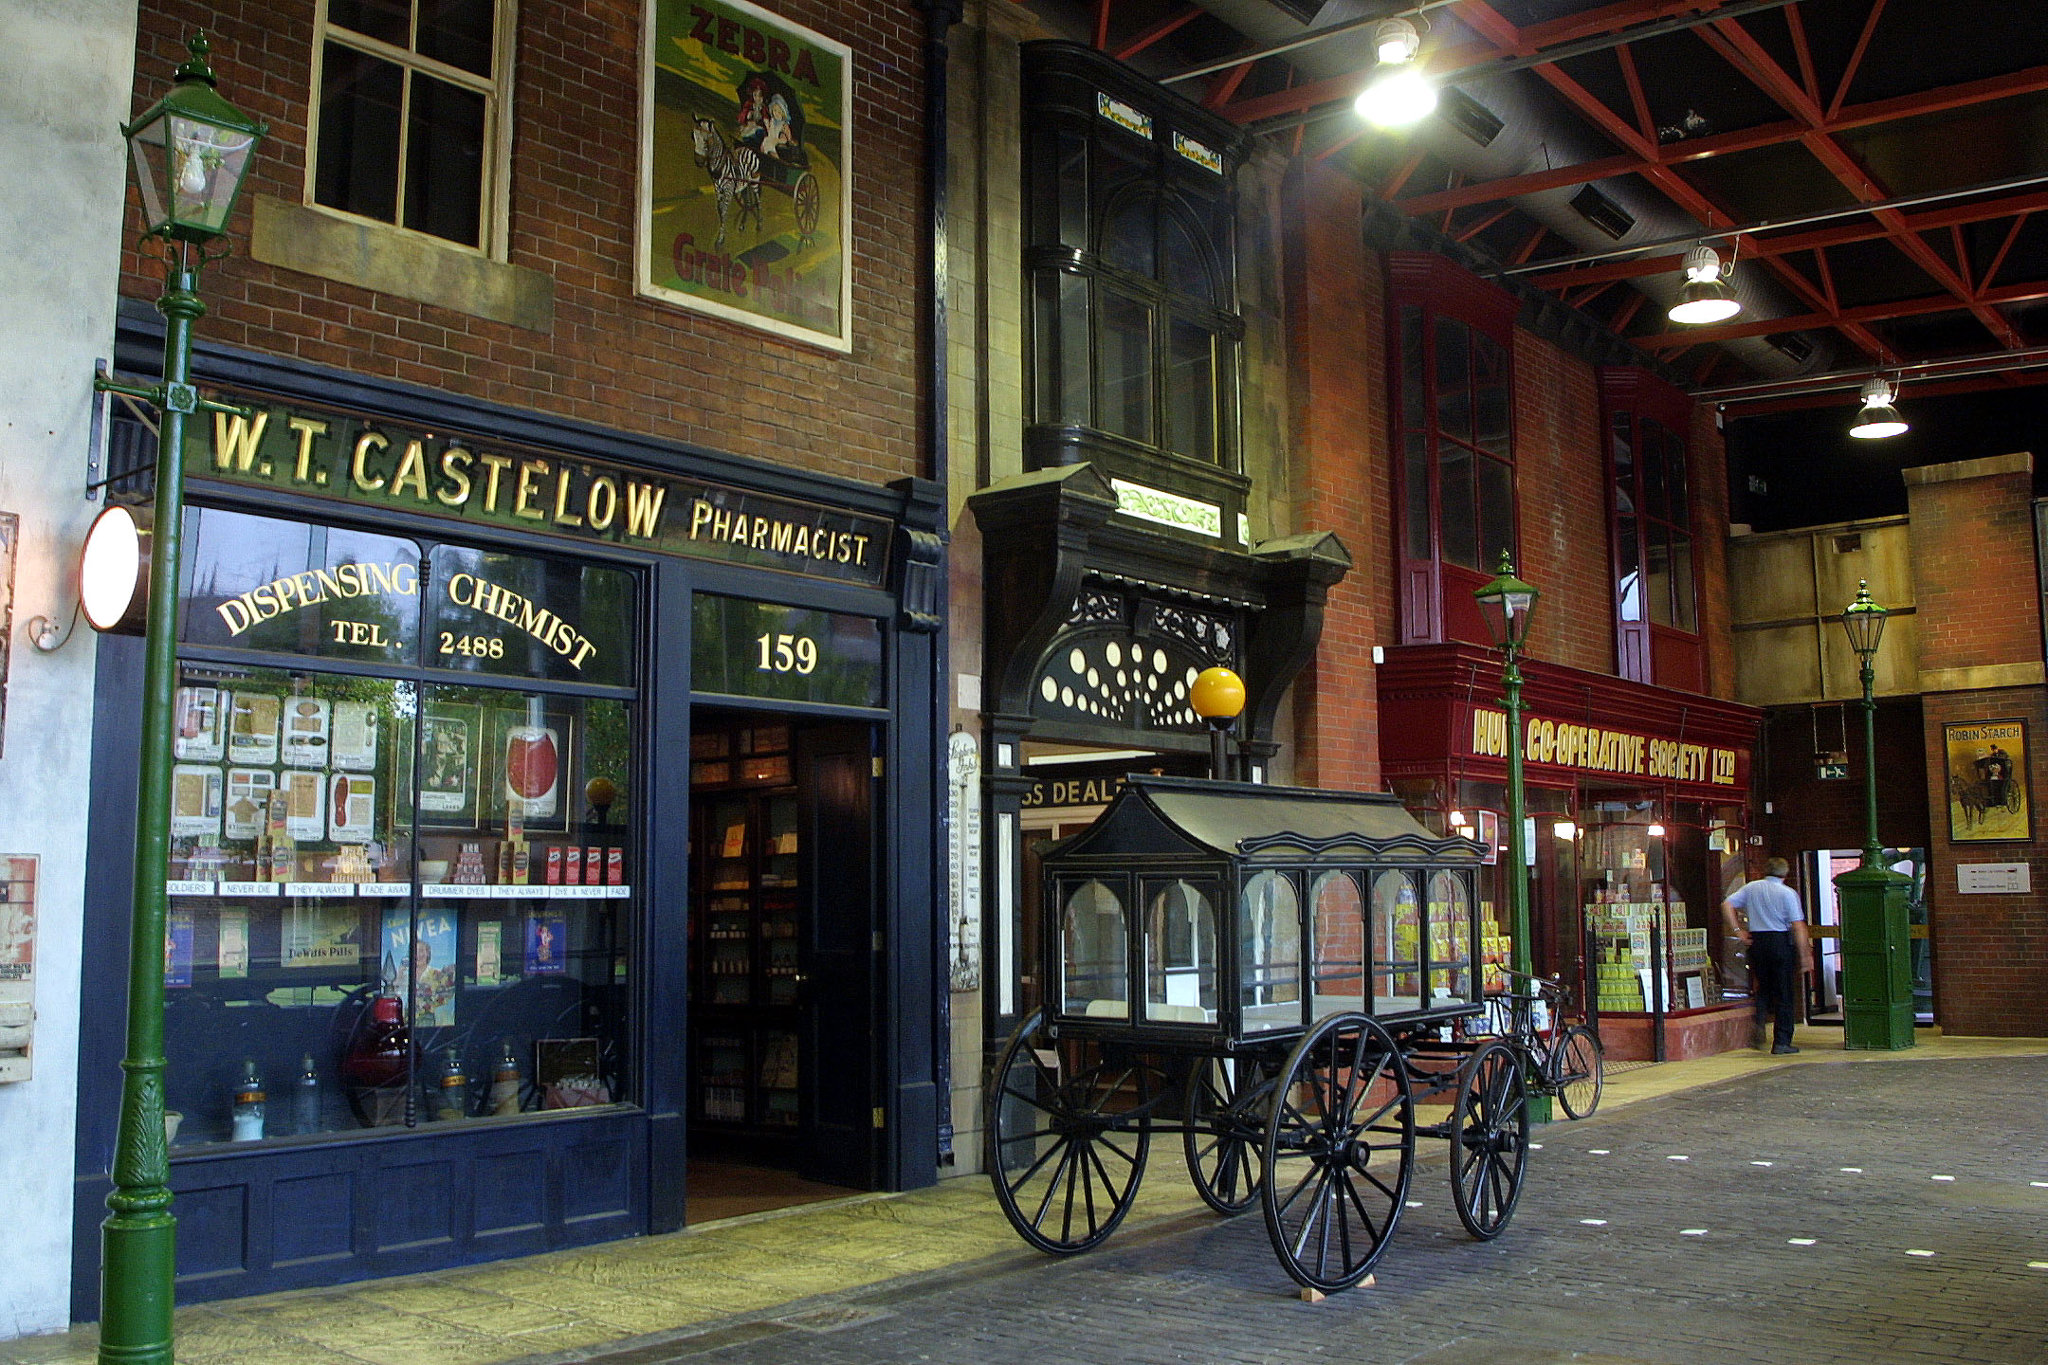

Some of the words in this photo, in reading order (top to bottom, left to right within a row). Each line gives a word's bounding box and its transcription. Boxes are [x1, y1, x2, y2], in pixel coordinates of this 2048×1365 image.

[689, 6, 820, 88] ZEBRA
[673, 233, 747, 297] Grate
[213, 408, 273, 475] W.
[290, 420, 328, 485] T.
[353, 432, 664, 539] CASTELOW
[215, 562, 419, 638] DISPENSING
[449, 572, 597, 672] CHEMIST
[439, 631, 505, 660] 2488
[757, 631, 818, 676] 159
[1949, 728, 1979, 741] ROBIN
[1981, 726, 2019, 740] STARCH
[1527, 718, 1645, 775] CO-OPERATIVE
[1650, 738, 1708, 782] SOCIETY
[1712, 748, 1735, 784] LTD
[227, 884, 254, 894] NEVER
[257, 884, 271, 894] DIE
[293, 885, 312, 894] THEY
[316, 885, 347, 894] ALWAYS
[365, 885, 383, 894] FADE
[387, 885, 409, 894] AWAY
[429, 886, 464, 896] DRUMMER
[467, 886, 486, 896] DYES
[499, 887, 514, 896] THEY
[518, 887, 544, 896] ALWAYS
[581, 888, 601, 897] NEVER
[611, 888, 627, 897] FADE
